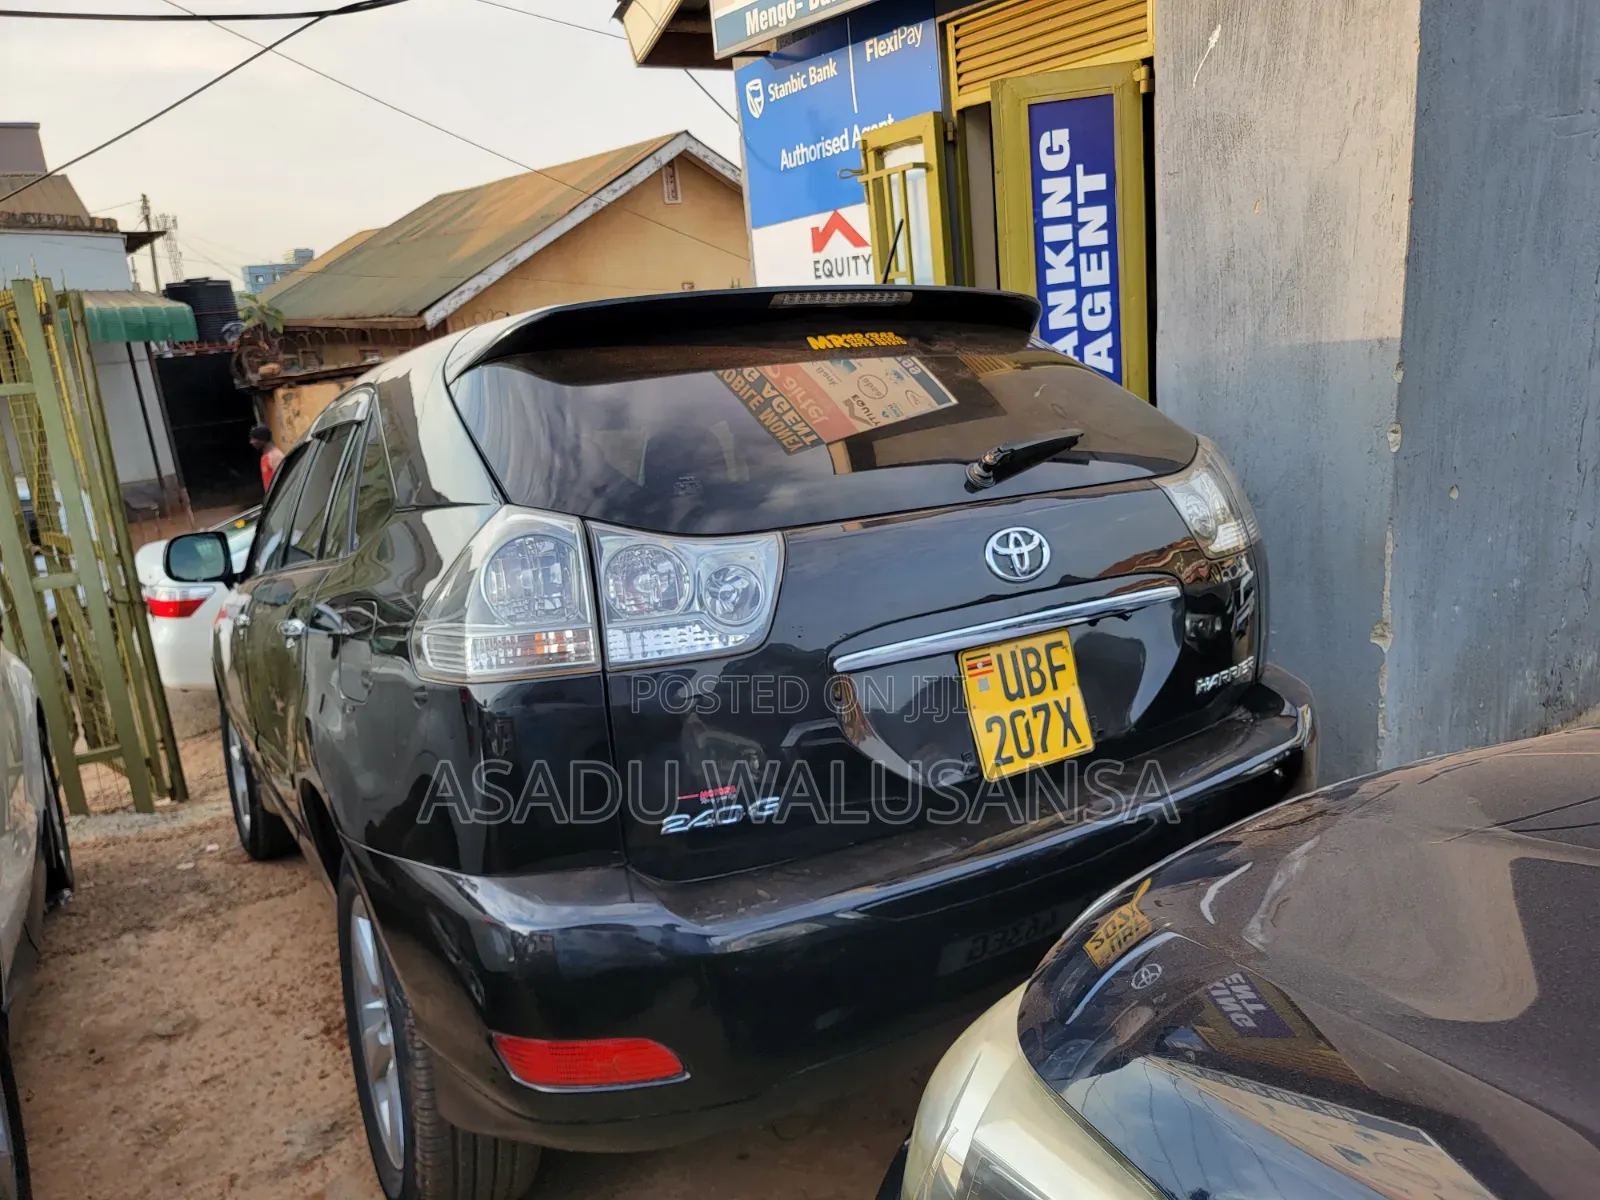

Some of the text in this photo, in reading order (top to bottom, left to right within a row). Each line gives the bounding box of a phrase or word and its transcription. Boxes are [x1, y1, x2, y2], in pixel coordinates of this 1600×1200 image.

[745, 0, 803, 37] Mengo-
[865, 23, 923, 62] FlexiPay
[767, 57, 838, 102] Stanbic Bank
[780, 127, 850, 171] Authorised
[813, 254, 873, 280] EQUITY
[1076, 163, 1114, 374] AGENT
[996, 640, 1066, 702] UBF
[1195, 655, 1255, 695] HARRIER
[985, 697, 1082, 767] 207X
